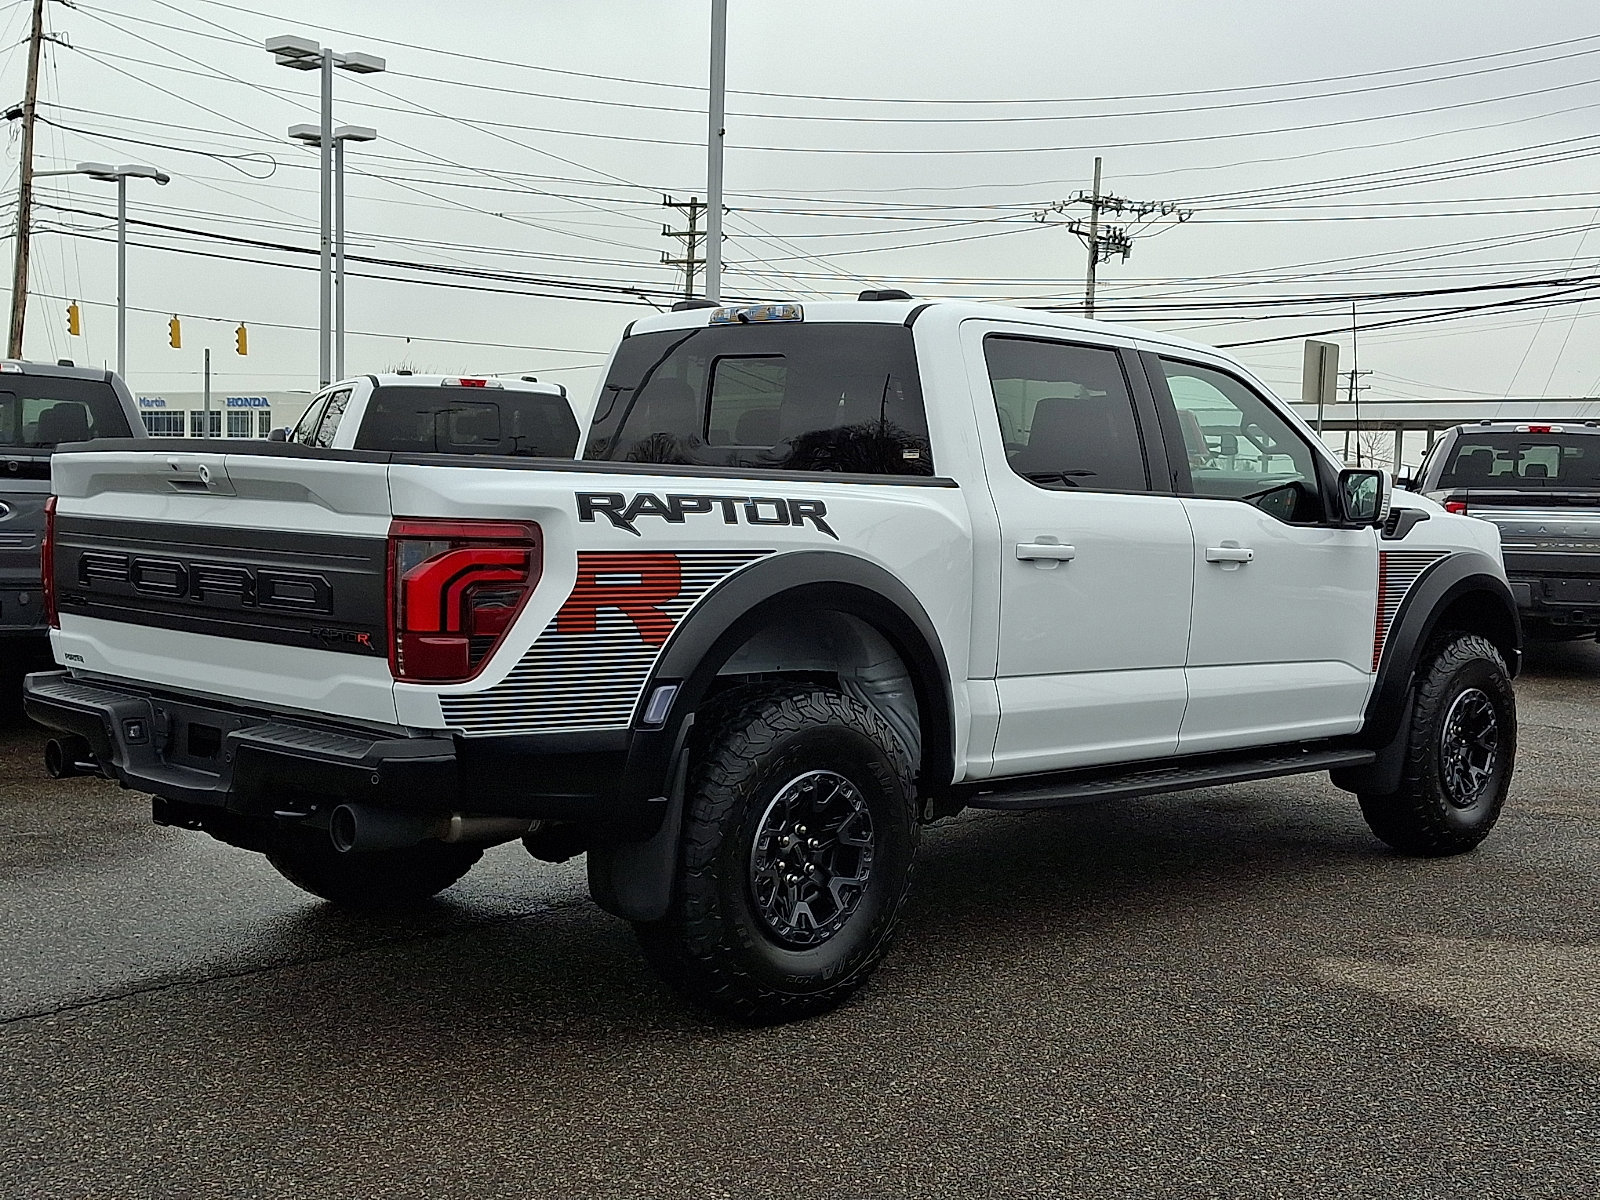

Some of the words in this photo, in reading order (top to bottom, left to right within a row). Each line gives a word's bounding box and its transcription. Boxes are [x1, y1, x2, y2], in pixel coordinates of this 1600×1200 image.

[138, 396, 165, 408] Martin
[226, 397, 270, 408] HONDA
[575, 491, 840, 541] RAPTOR
[78, 551, 333, 615] FORD
